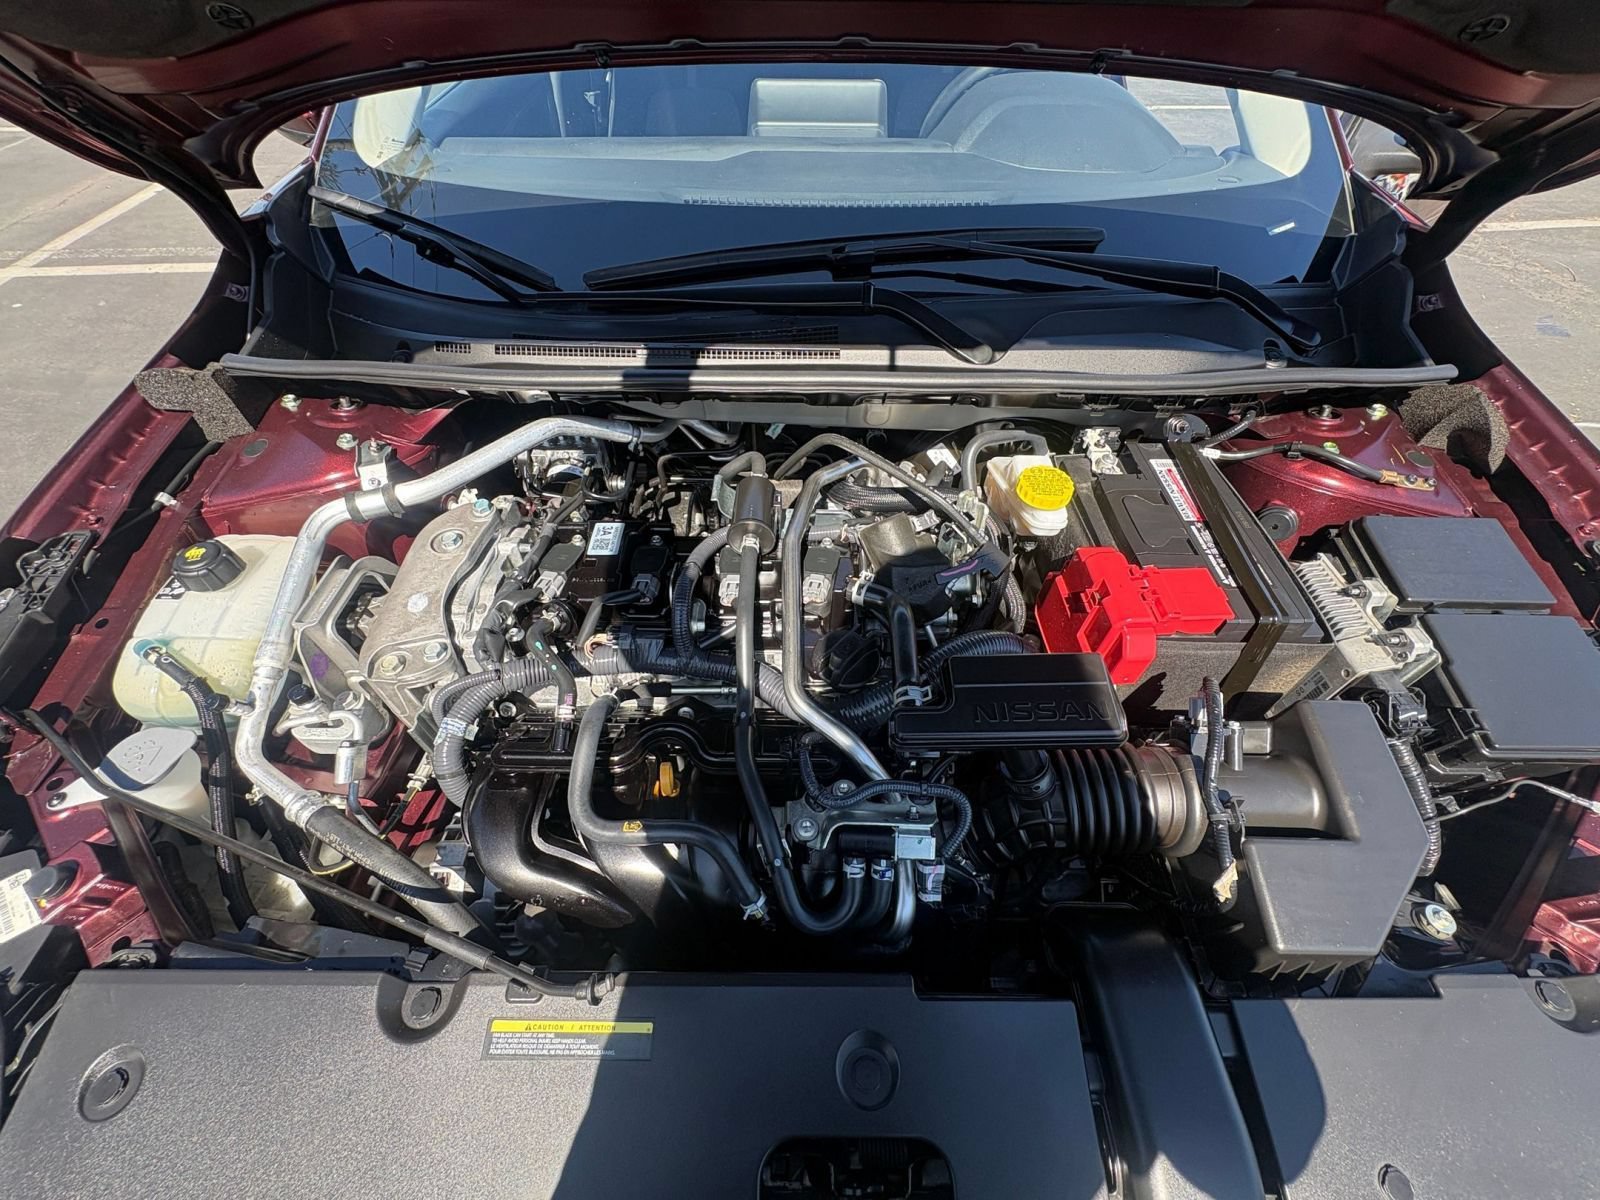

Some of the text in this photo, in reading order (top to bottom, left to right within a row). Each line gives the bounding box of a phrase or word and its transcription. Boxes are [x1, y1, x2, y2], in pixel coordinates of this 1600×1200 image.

[600, 526, 613, 537] 3A
[975, 701, 1113, 723] NISSAN
[578, 1024, 616, 1032] ATTENTION
